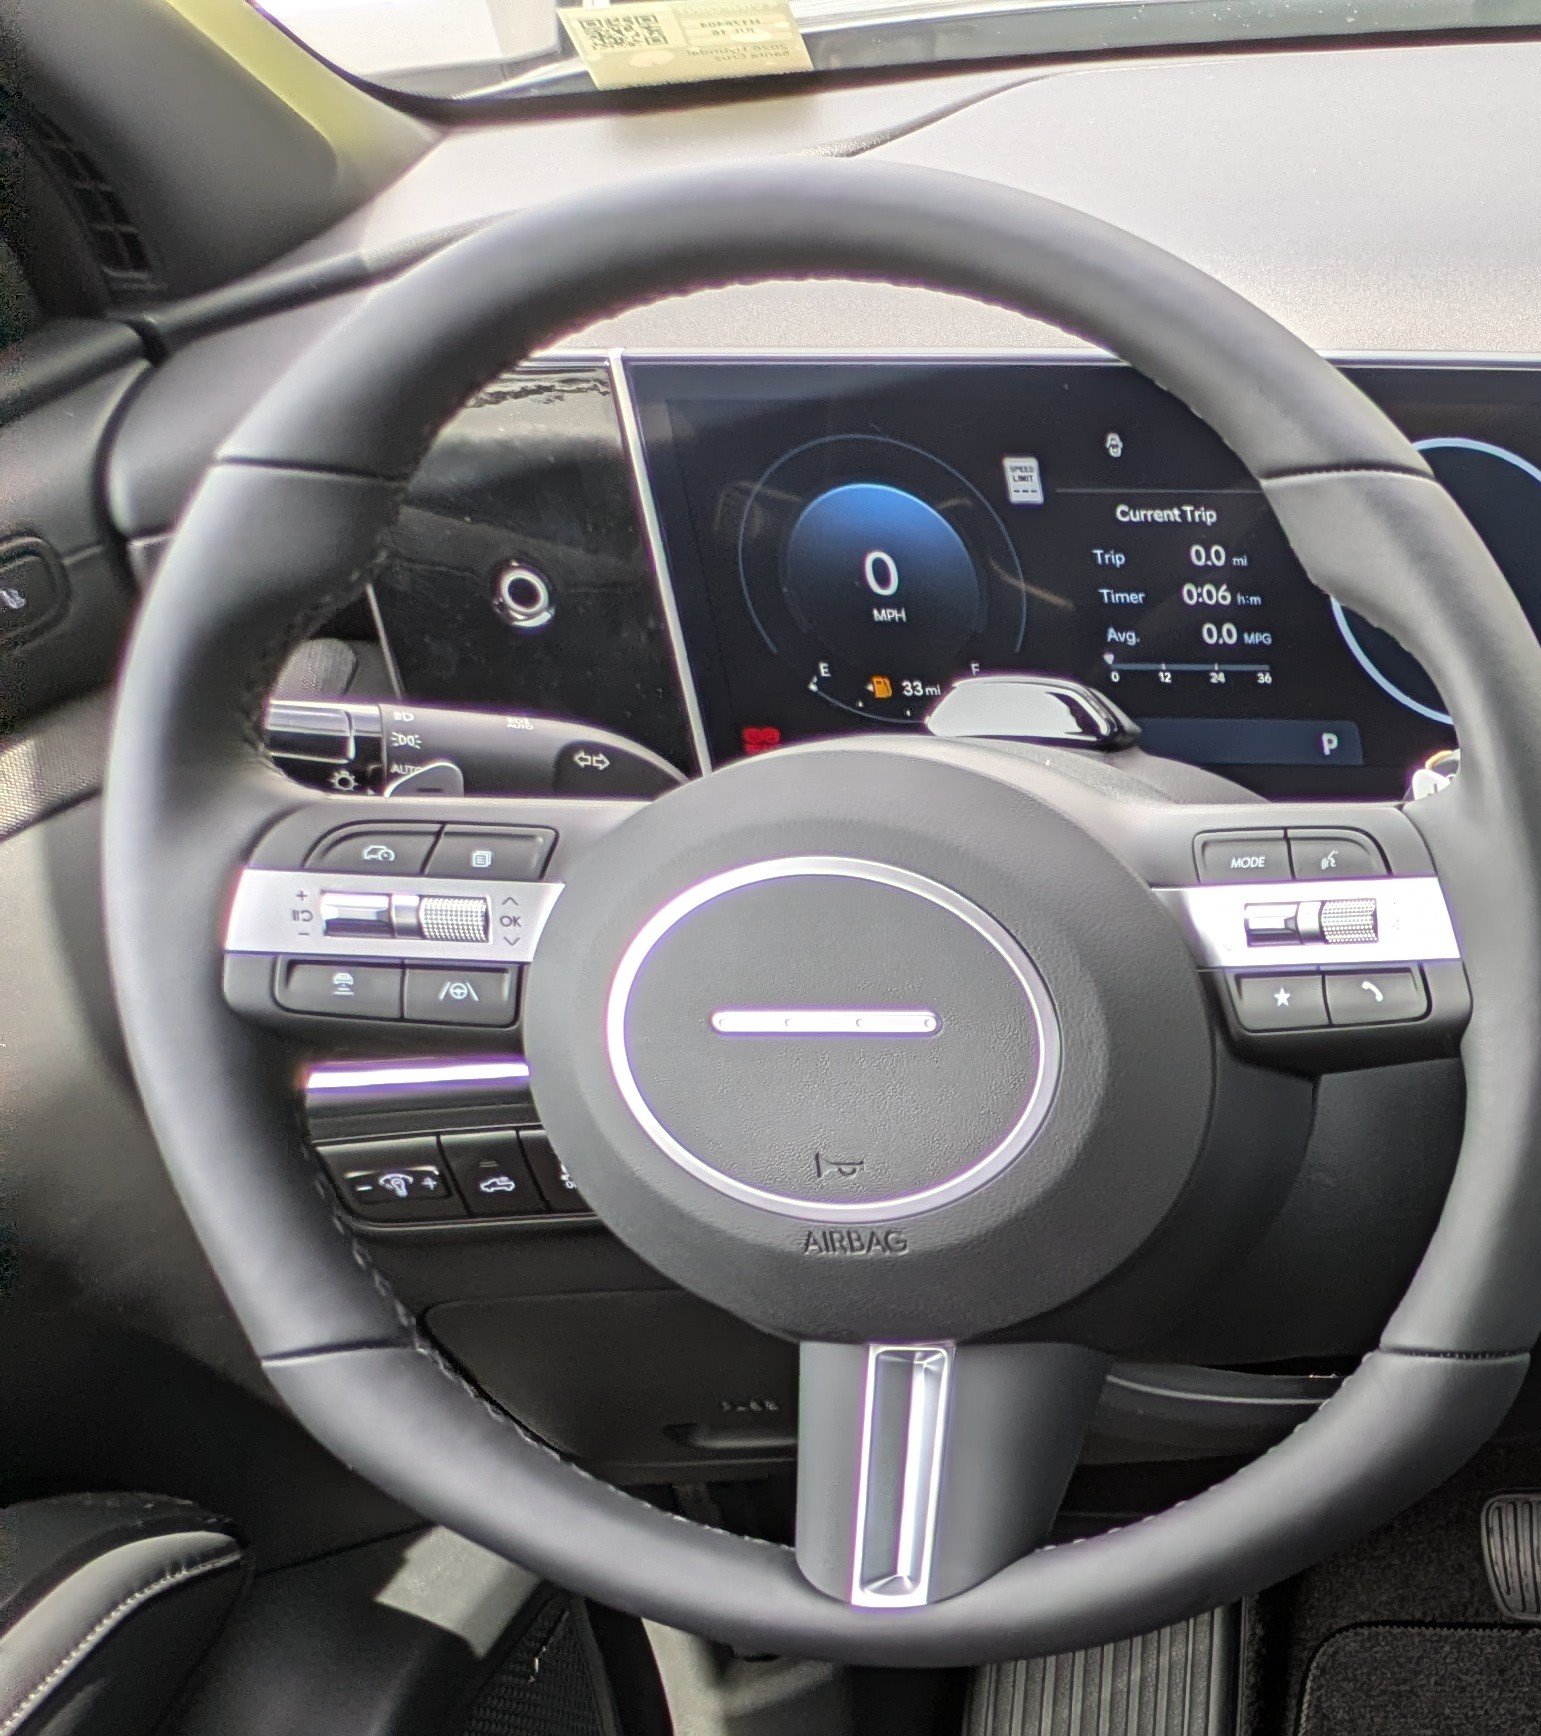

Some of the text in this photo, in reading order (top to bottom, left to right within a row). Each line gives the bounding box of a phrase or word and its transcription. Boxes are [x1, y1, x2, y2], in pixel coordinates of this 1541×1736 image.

[1115, 504, 1217, 526] Current Trip
[1092, 549, 1126, 569] Trip
[1190, 544, 1249, 568] 0.0 mi
[864, 551, 899, 596] 0
[1098, 588, 1146, 606] Timer
[1182, 582, 1262, 606] 0:06 h:m
[872, 606, 907, 622] MPH
[1106, 627, 1141, 646] Avg.
[1201, 622, 1273, 646] 0.0 MPG
[818, 661, 832, 677] E
[970, 661, 980, 677] F
[1110, 670, 1273, 685] 0 12 24 36
[901, 680, 941, 697] 33 mi
[1321, 732, 1338, 756] P
[1230, 856, 1266, 869] MODE
[500, 914, 522, 928] OK
[803, 1230, 909, 1254] AIRBAG
